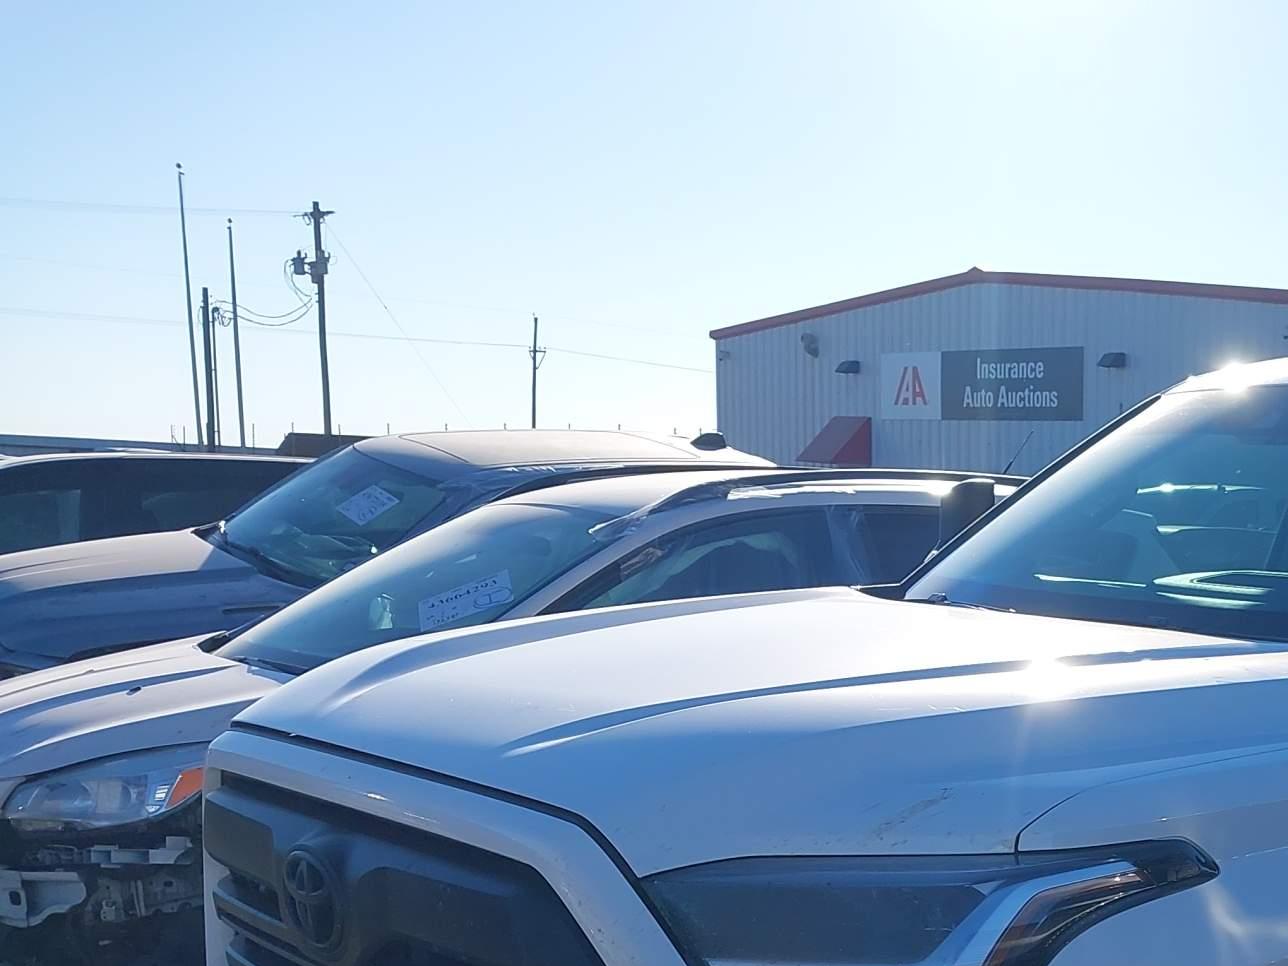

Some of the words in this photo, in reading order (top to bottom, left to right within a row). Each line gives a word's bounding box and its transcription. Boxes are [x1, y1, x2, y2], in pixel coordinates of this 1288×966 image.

[976, 358, 1044, 379] Insurance
[963, 386, 993, 408] Auto
[998, 386, 1058, 408] Auctions
